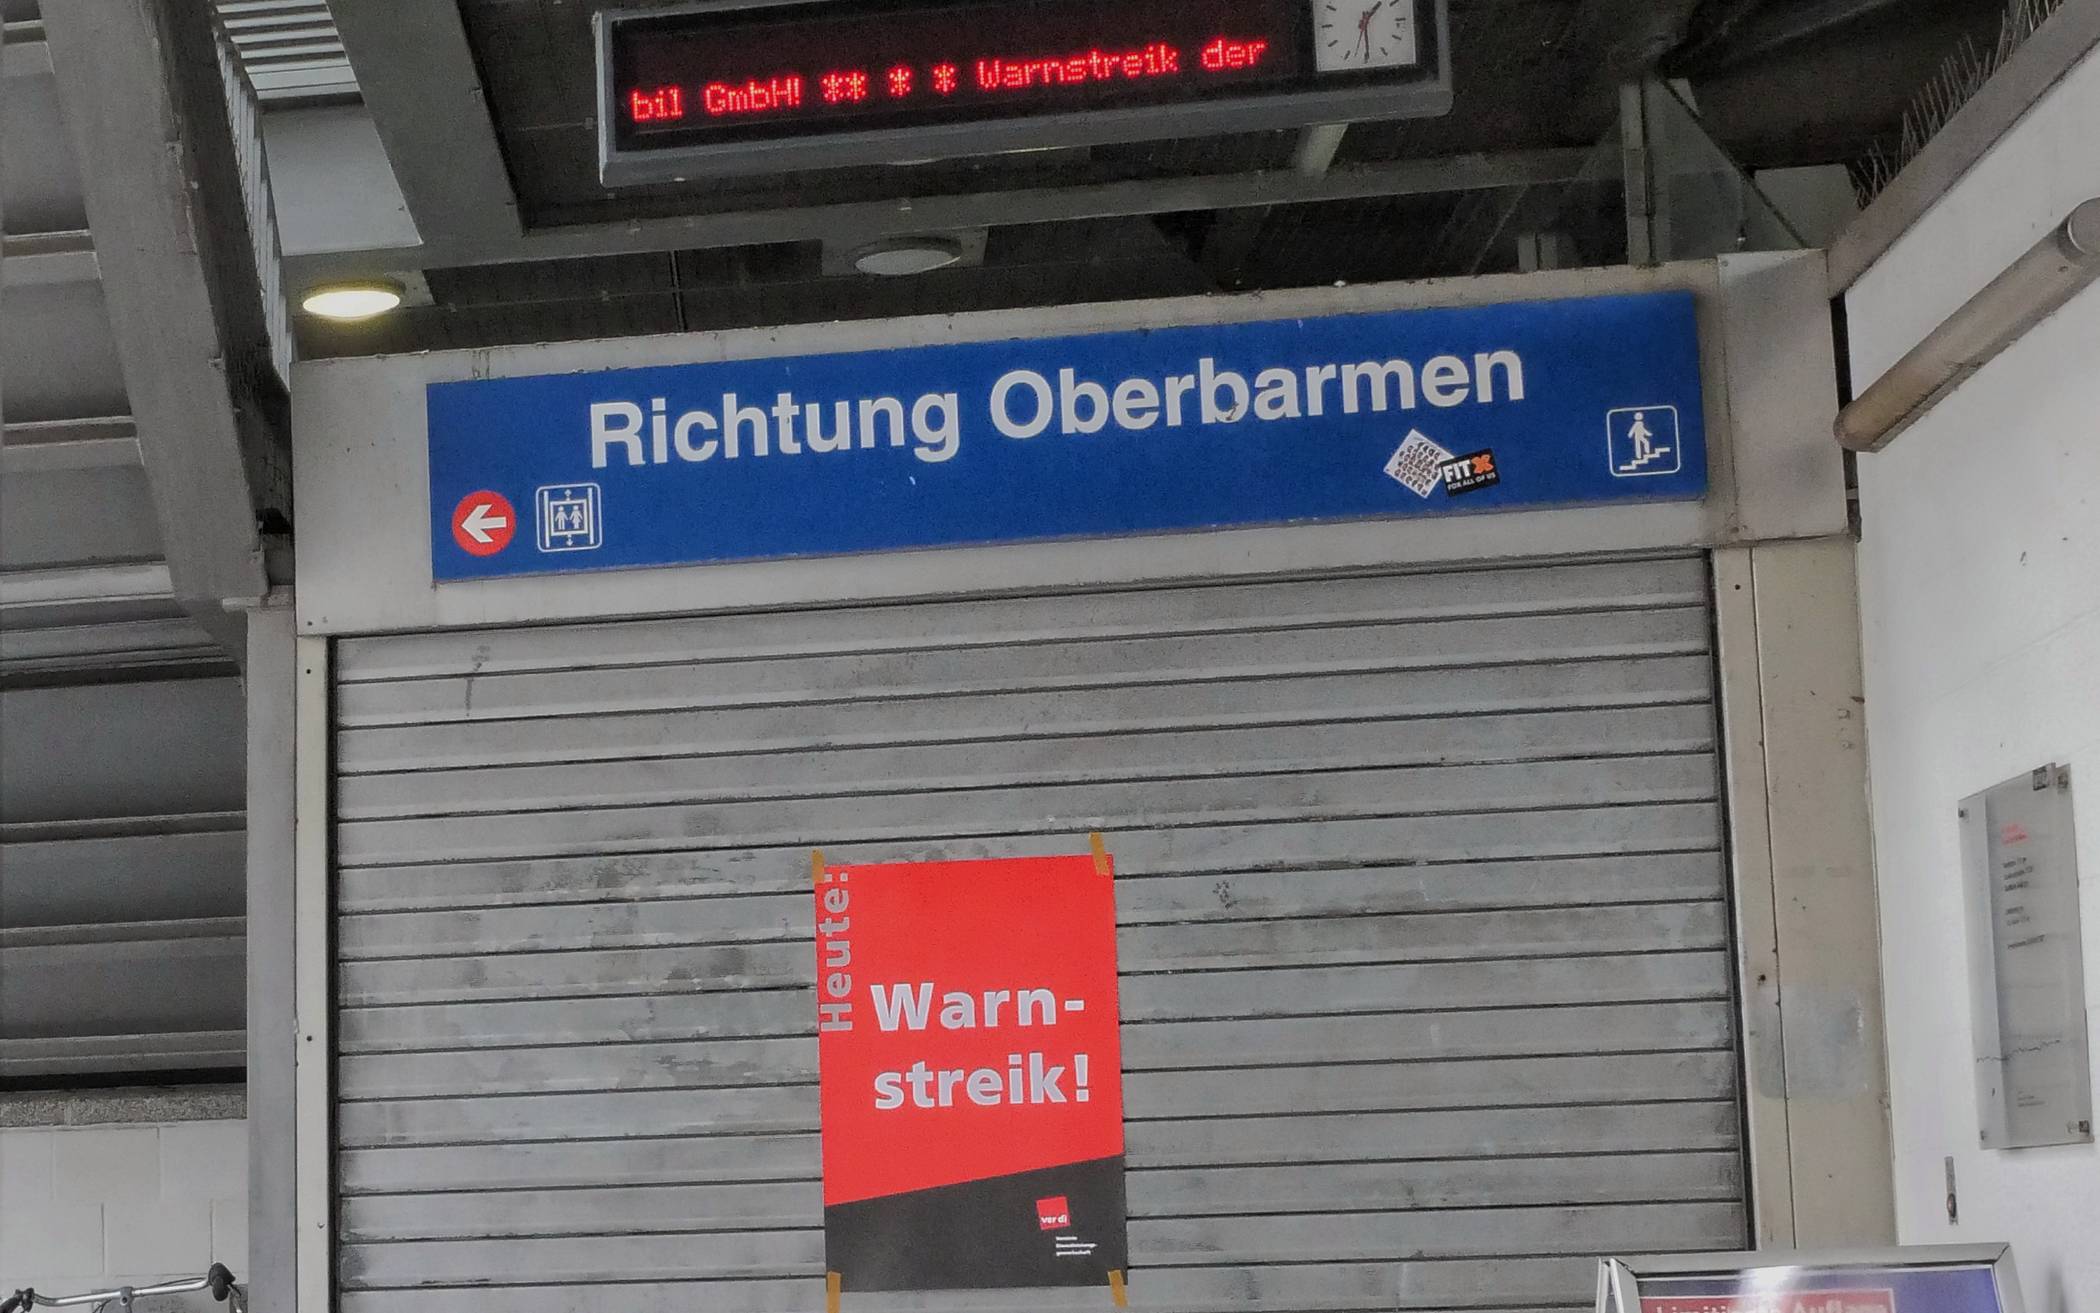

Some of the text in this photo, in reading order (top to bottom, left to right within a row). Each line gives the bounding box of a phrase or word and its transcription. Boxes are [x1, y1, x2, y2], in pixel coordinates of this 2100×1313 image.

[632, 89, 682, 121] bil
[704, 78, 801, 114] GmbH!
[977, 43, 1179, 89] Warnstreik
[1202, 38, 1267, 70] der
[590, 349, 1524, 468] Richtung Oberbarmen
[818, 871, 852, 1032] Heute:
[870, 982, 1085, 1032] Warn-
[874, 1052, 1090, 1109] streik!
